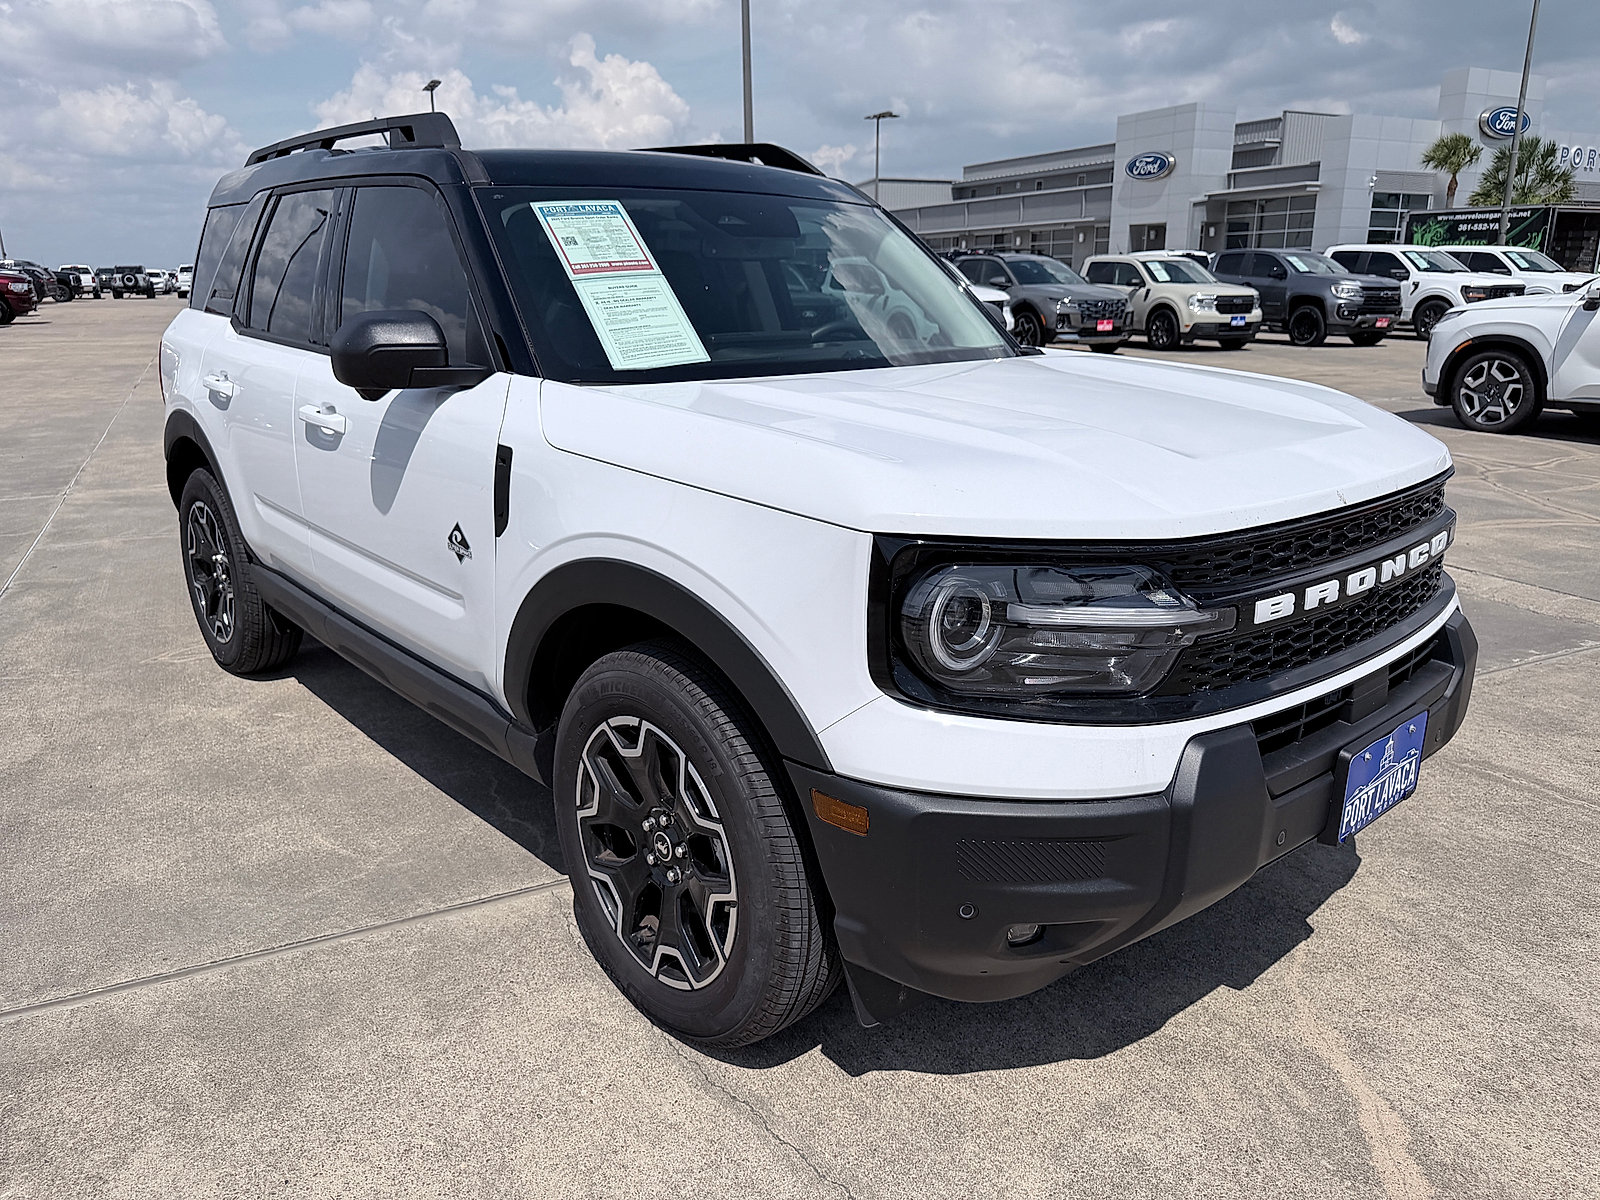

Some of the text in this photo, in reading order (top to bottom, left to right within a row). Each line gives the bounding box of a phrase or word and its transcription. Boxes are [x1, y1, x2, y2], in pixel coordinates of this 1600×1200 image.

[1132, 157, 1161, 176] Ford
[1560, 146, 1600, 167] POR
[542, 204, 615, 213] PORT LAVACA
[1437, 210, 1531, 221] www.marvelousgarns.net
[1253, 530, 1449, 625] BRONCO
[1341, 758, 1417, 834] PORT LAVACA
